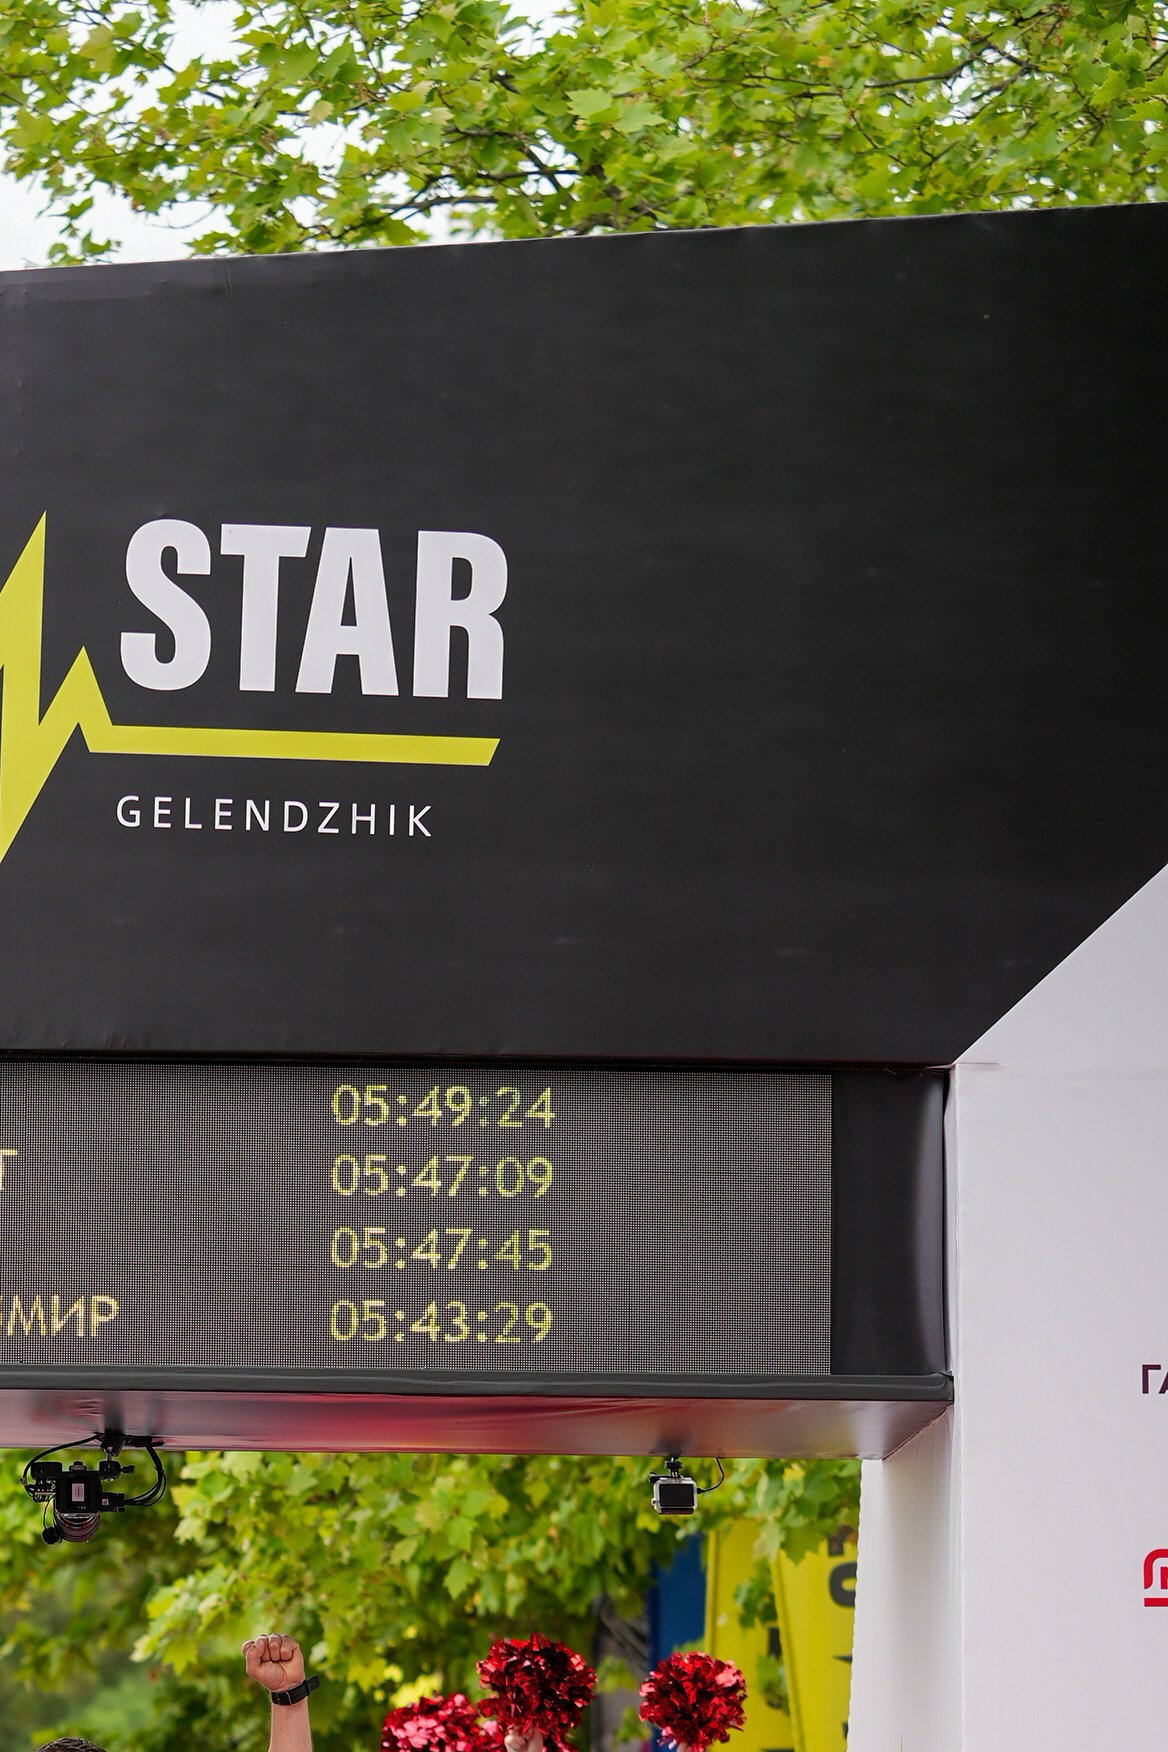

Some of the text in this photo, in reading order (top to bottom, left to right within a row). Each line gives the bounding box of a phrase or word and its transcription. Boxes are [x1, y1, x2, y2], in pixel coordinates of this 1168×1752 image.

[119, 518, 510, 701] STAR
[115, 795, 434, 839] GELENDZHIK
[331, 1084, 556, 1128] 05:49:24
[331, 1154, 554, 1198] 05:47:09
[331, 1226, 553, 1271] 05:47:45
[330, 1299, 553, 1344] 05:43:29
